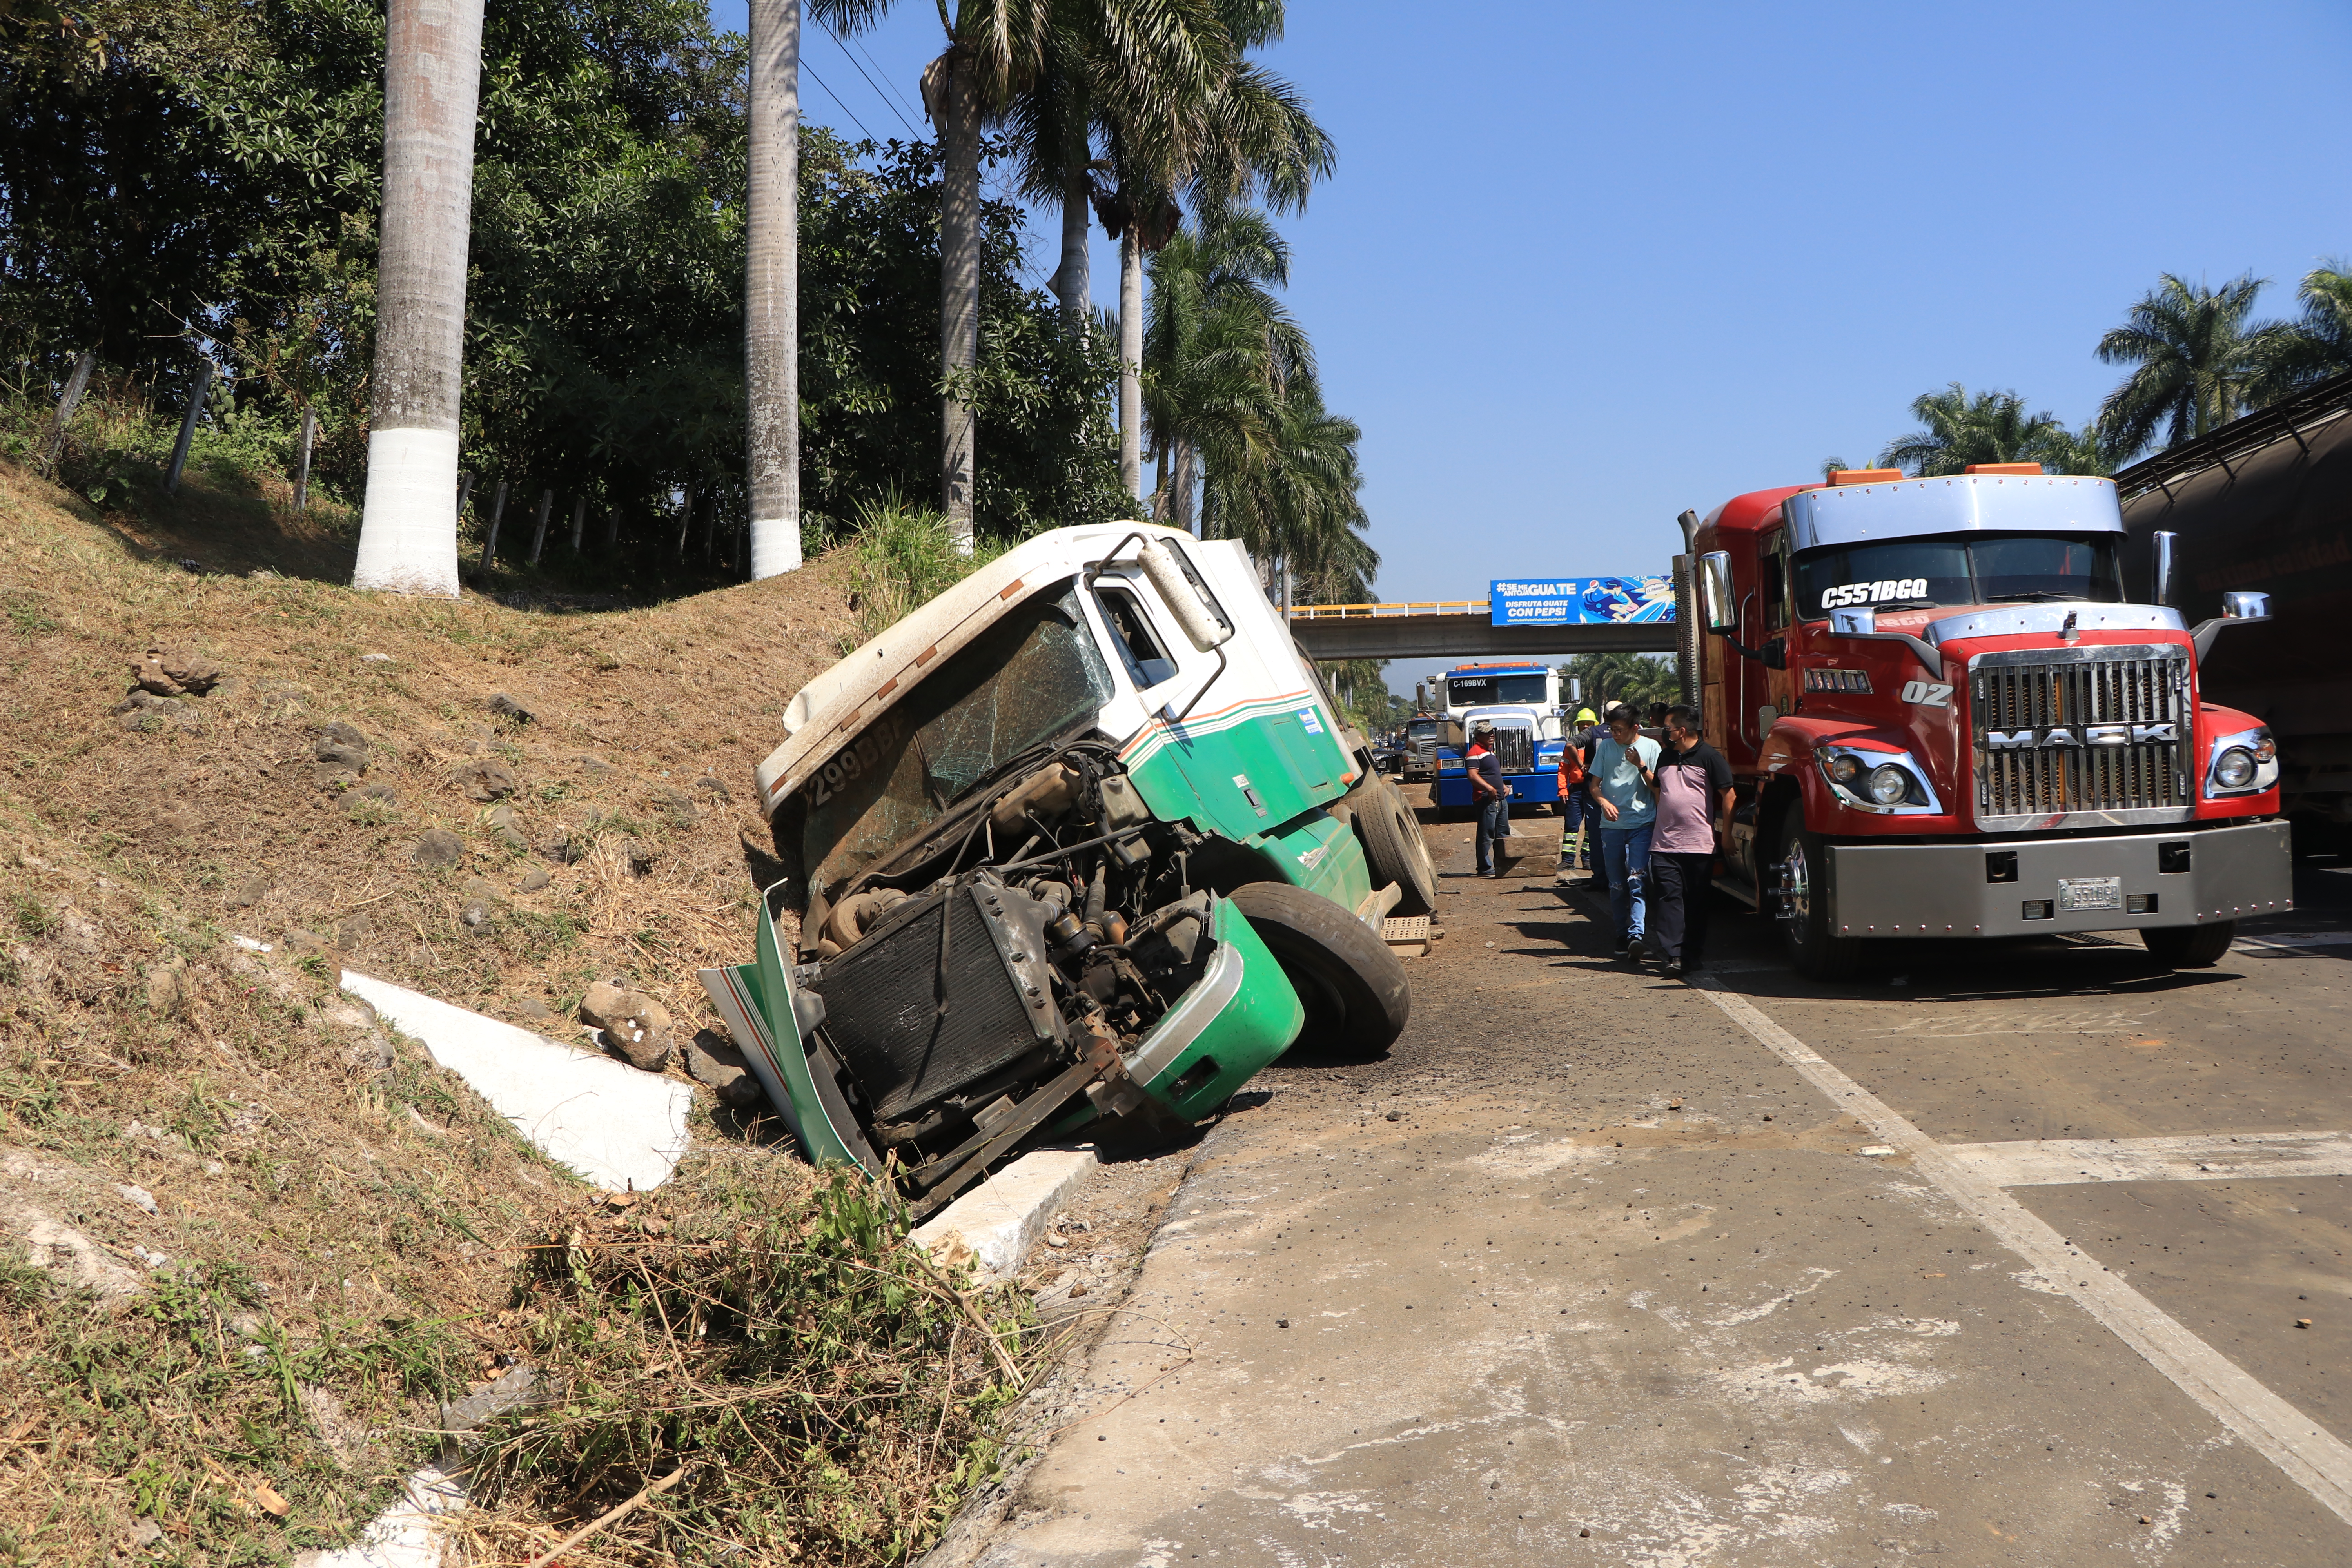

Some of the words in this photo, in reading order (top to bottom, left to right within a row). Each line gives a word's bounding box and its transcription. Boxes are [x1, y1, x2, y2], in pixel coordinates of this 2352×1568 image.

[1820, 578, 1927, 609] C551BGQ
[1508, 608, 1533, 617] CON
[1534, 607, 1566, 617] PEPSI
[1453, 679, 1486, 688] C-169BVX
[1901, 681, 1954, 707] 02
[1987, 723, 2178, 749] MACK
